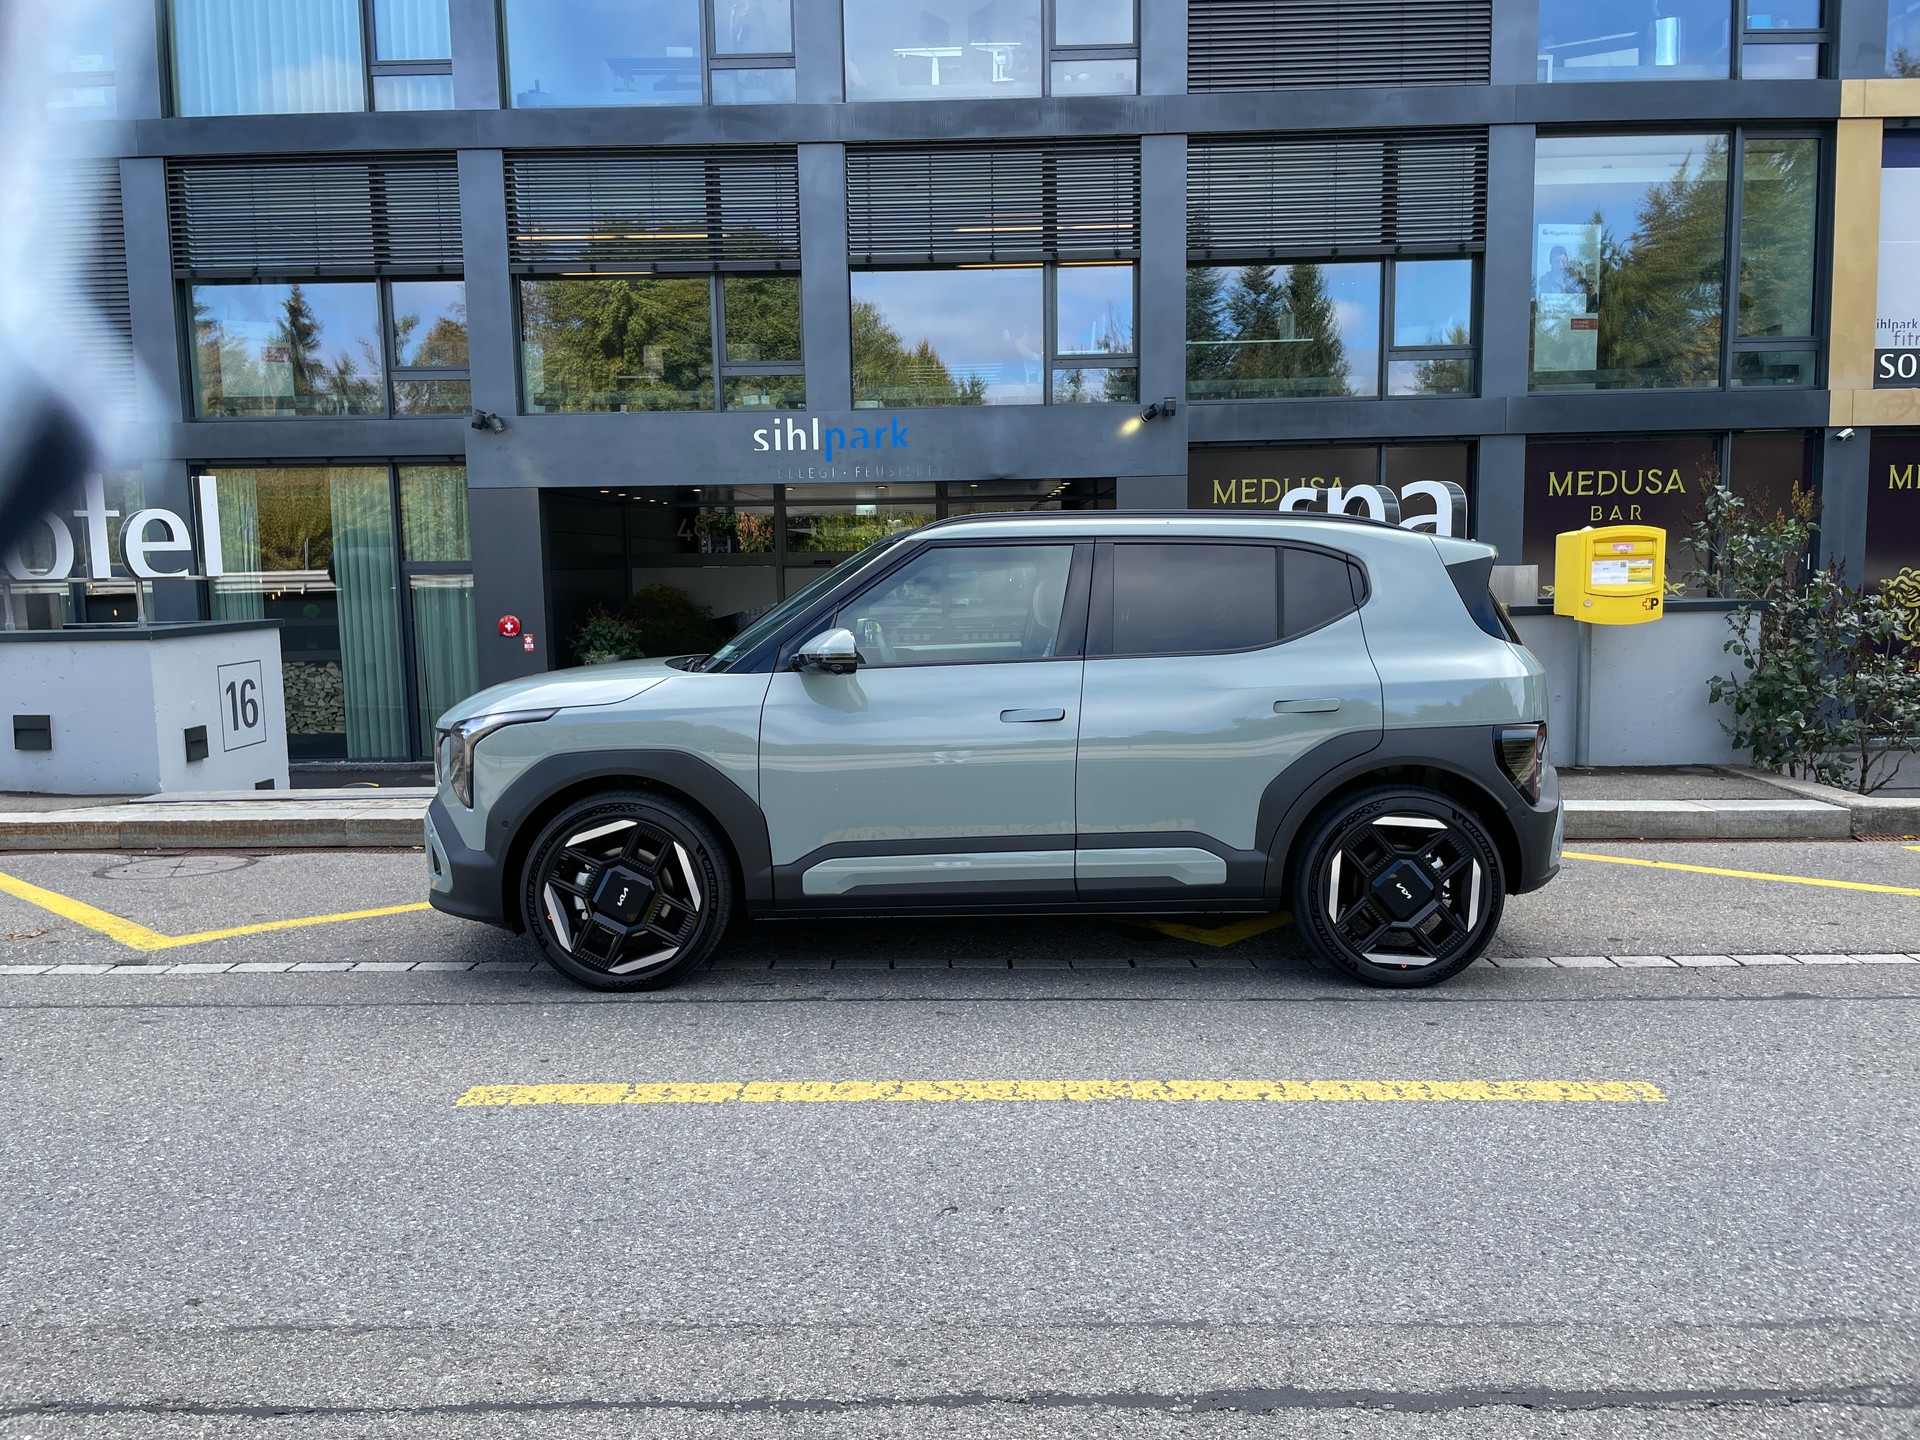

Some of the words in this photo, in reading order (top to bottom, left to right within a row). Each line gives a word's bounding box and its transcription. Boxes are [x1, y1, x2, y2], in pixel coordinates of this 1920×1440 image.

[1876, 318, 1918, 332] ihlpark
[1879, 353, 1920, 379] SO
[753, 416, 909, 462] sihlpark
[1548, 468, 1686, 497] MEDUSA
[1888, 464, 1920, 490] M
[1590, 504, 1642, 521] BAR
[225, 678, 259, 731] 16
